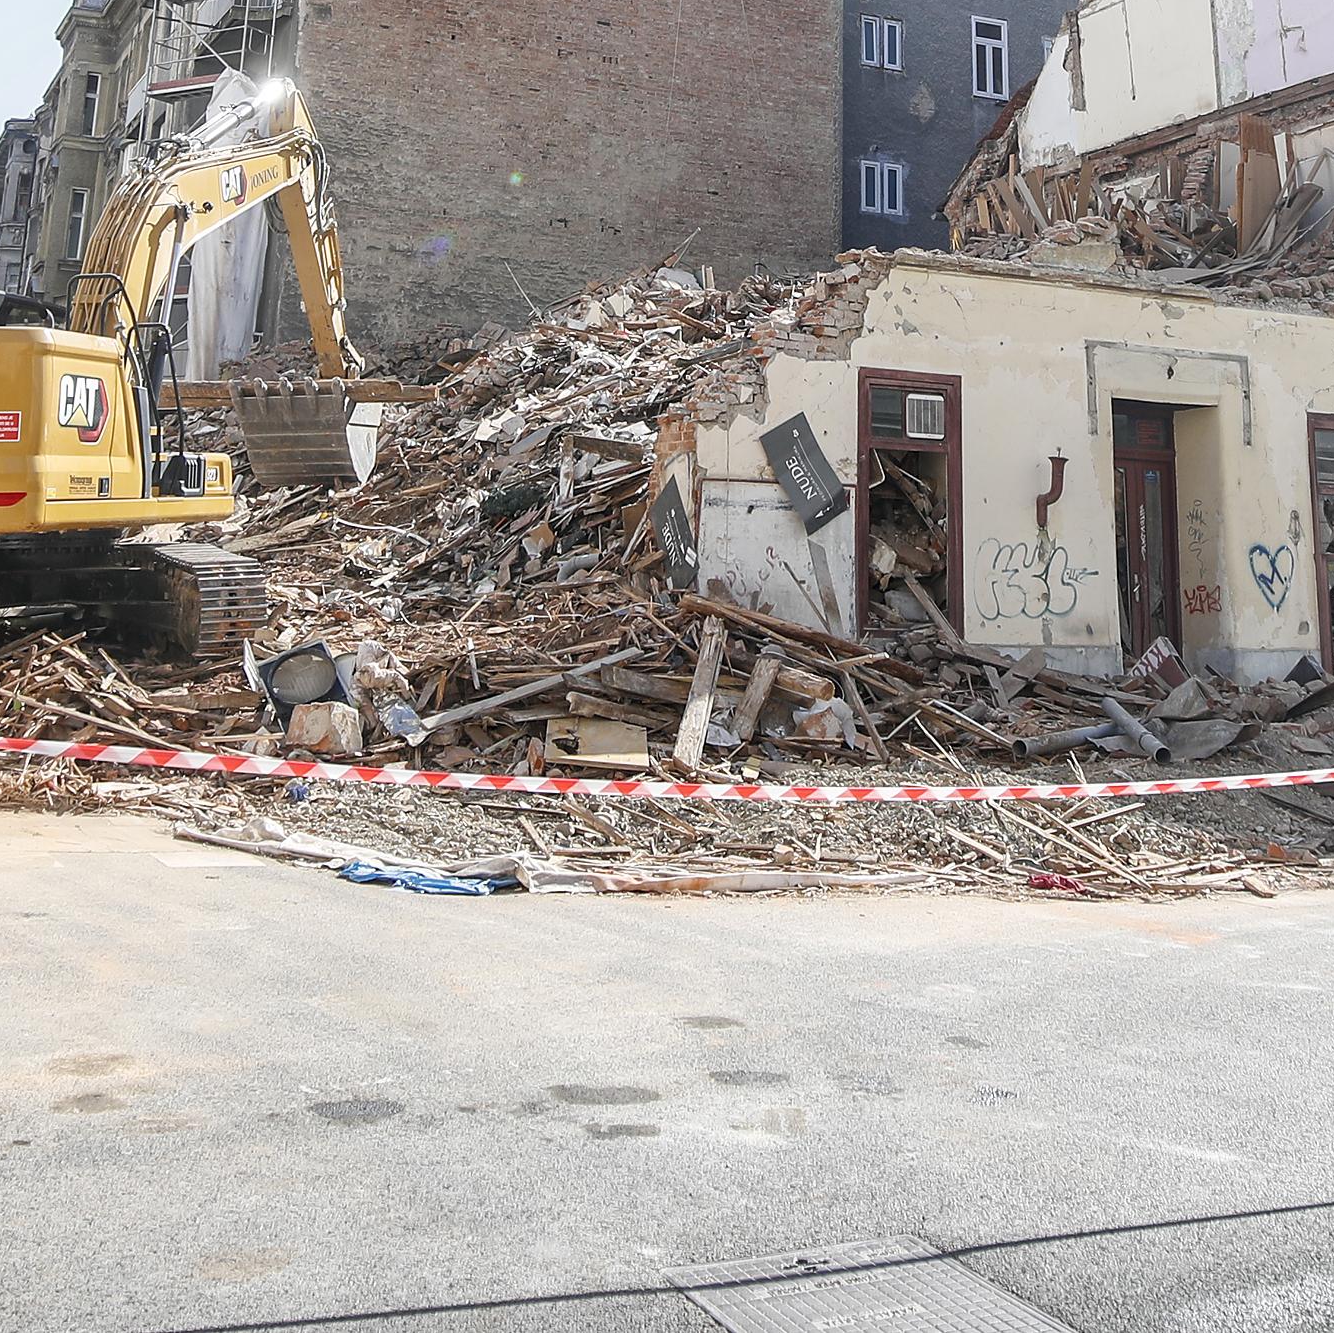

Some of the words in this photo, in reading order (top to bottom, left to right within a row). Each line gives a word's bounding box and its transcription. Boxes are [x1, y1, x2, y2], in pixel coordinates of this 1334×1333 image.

[221, 166, 242, 202] CAT
[58, 374, 99, 427] CAT
[785, 456, 818, 500] NUDE
[661, 522, 679, 567] NUDE
